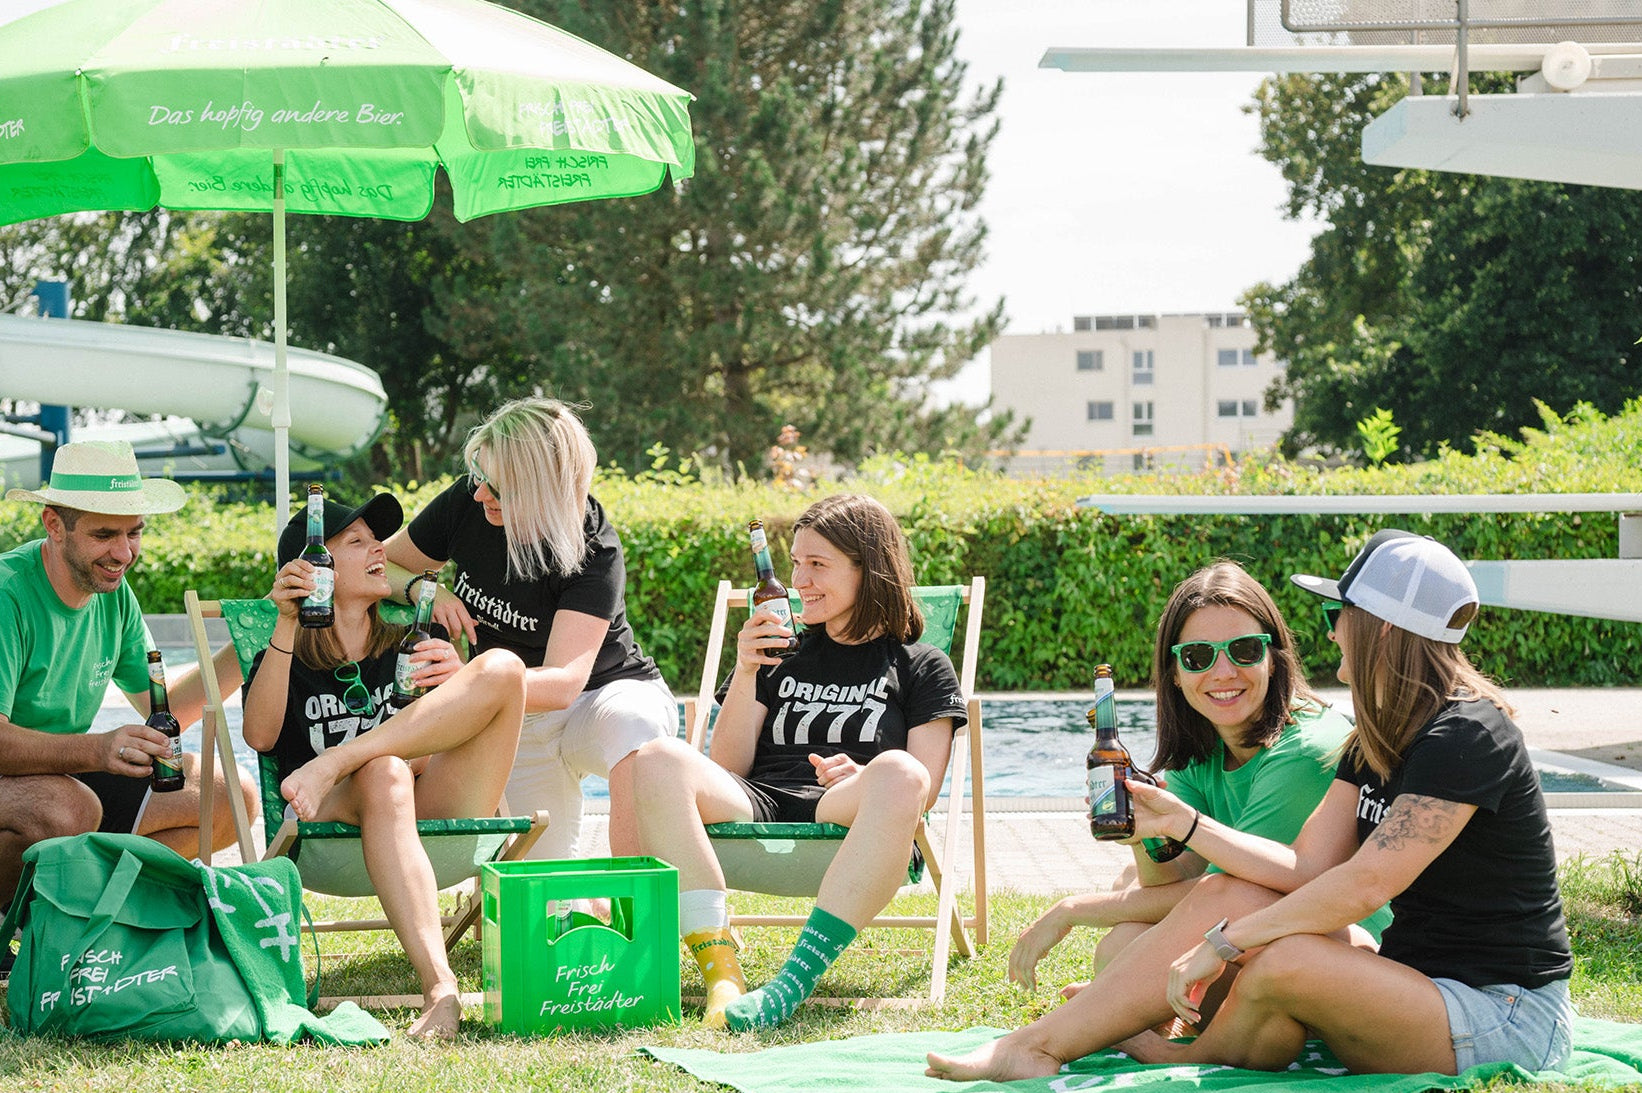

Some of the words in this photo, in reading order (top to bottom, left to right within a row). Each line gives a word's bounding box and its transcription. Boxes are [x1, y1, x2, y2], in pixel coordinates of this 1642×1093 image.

[147, 104, 194, 126] Das
[199, 100, 265, 131] hopfig
[270, 100, 349, 124] andere
[355, 103, 404, 126] Bier.
[453, 571, 539, 632] freistädter
[772, 698, 887, 745] 1777
[70, 966, 110, 986] FREI
[555, 954, 616, 984] Frisch
[539, 990, 645, 1017] Freistädter
[567, 979, 605, 998] Frei
